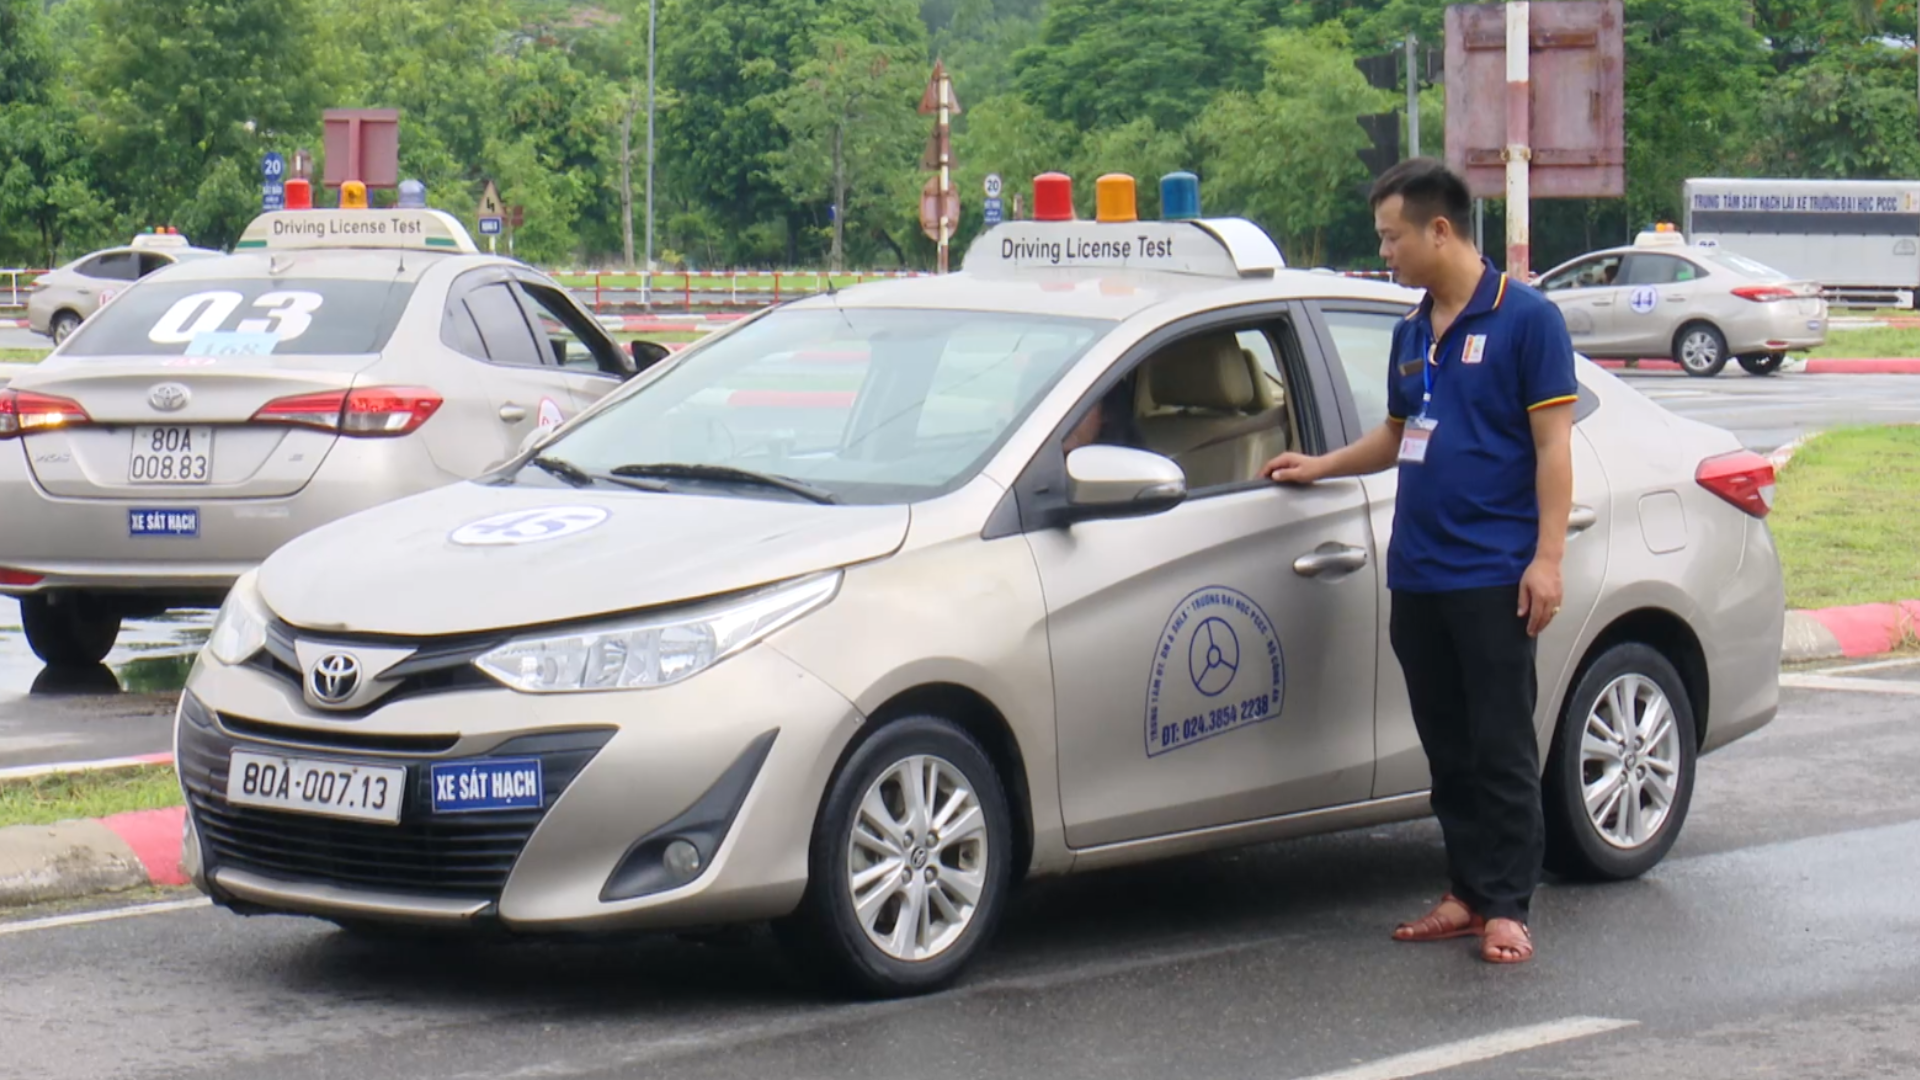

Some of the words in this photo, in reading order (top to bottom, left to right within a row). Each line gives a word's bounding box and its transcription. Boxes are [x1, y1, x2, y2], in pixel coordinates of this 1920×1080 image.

[264, 159, 281, 175] 20
[987, 179, 999, 191] 20
[1742, 193, 1758, 209] SÁT
[1796, 195, 1807, 210] XE
[1877, 196, 1897, 212] PCCC
[273, 219, 325, 238] Driving
[330, 219, 386, 235] License
[391, 217, 421, 234] Test
[1001, 238, 1061, 264] Driving
[1066, 237, 1131, 259] License
[1137, 235, 1172, 258] Test
[1632, 291, 1653, 308] 44
[148, 290, 323, 344] 03
[152, 428, 191, 452] 80A
[132, 455, 206, 479] 008.83
[131, 513, 145, 530] XE
[147, 511, 166, 530] SÁT
[168, 513, 196, 534] HẠCH
[1182, 704, 1237, 740] 024.3854
[1240, 693, 1269, 720] 2238
[436, 773, 456, 802] XE
[459, 767, 488, 800] SÁT
[492, 769, 537, 804] HẠCH
